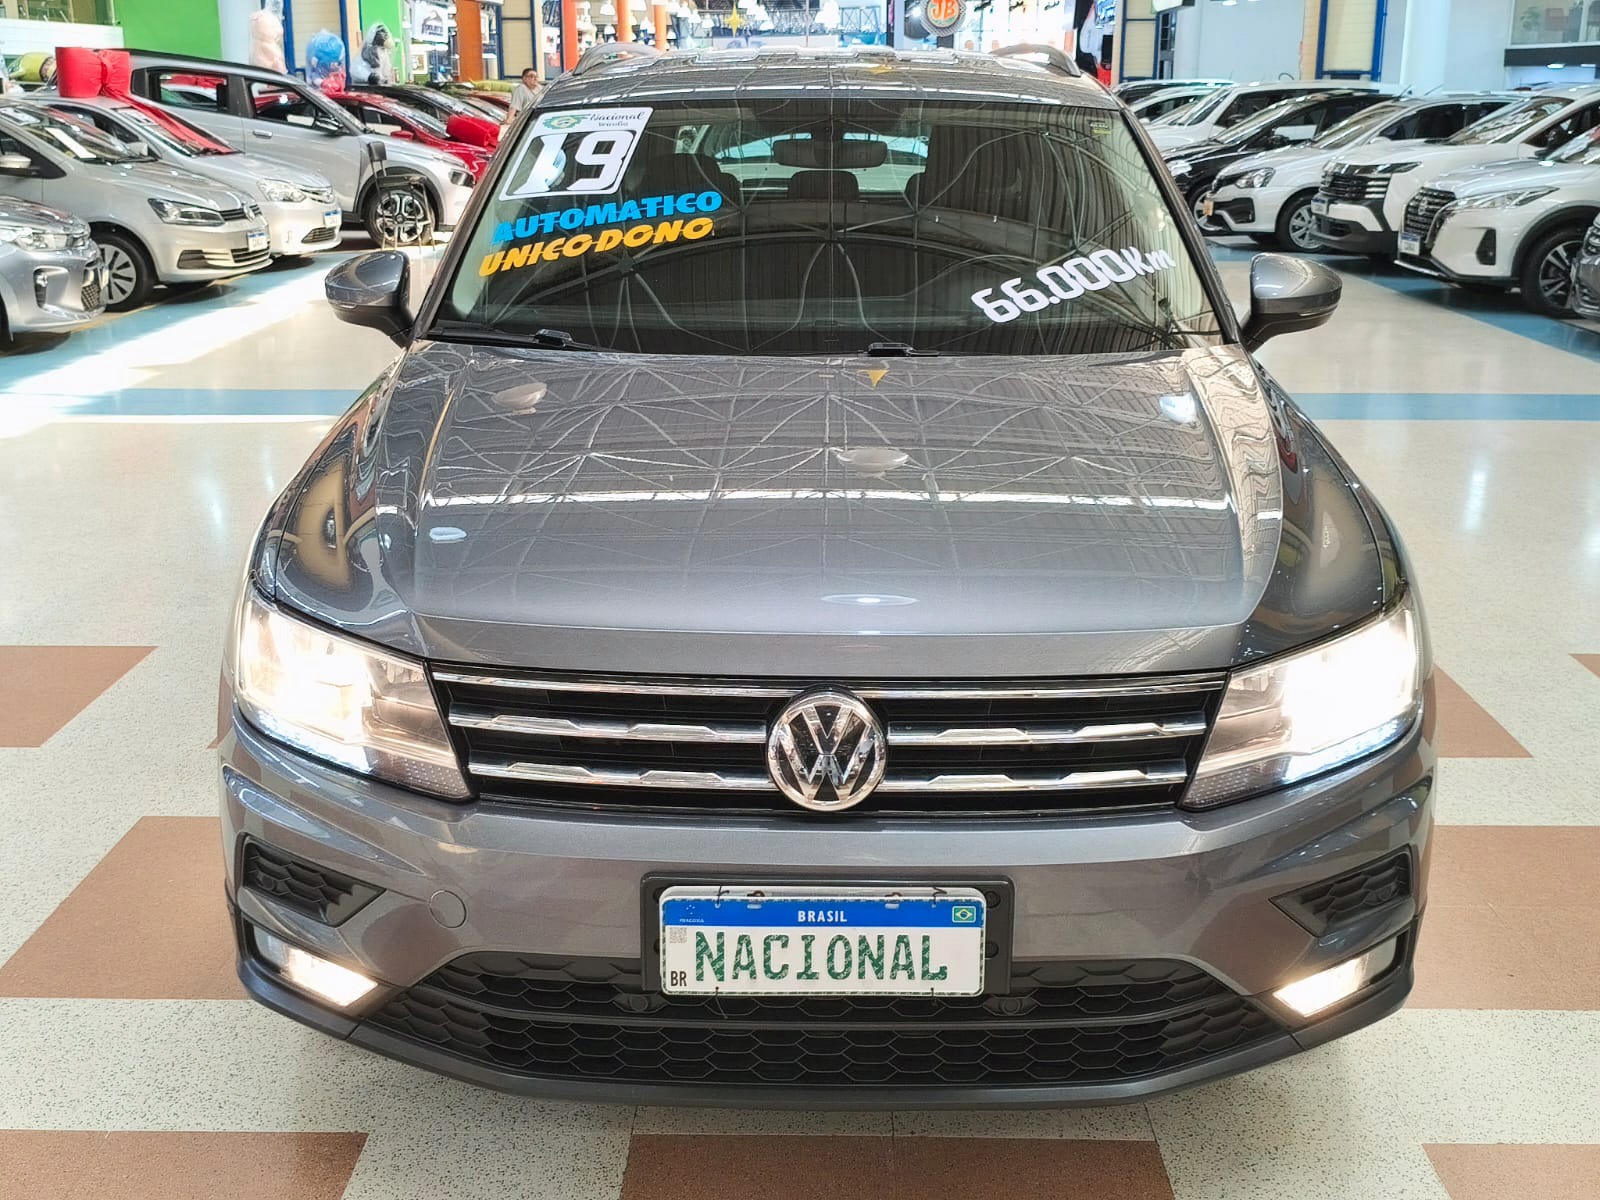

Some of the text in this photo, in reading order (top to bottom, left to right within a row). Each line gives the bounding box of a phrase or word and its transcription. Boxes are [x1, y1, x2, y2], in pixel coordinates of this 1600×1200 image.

[931, 0, 956, 20] JB
[590, 111, 645, 121] Nacional
[512, 130, 635, 195] 19
[491, 191, 722, 244] AUTOMATICO
[797, 910, 848, 923] BRASIL
[695, 931, 948, 981] NACIONAL
[670, 970, 687, 987] BR
